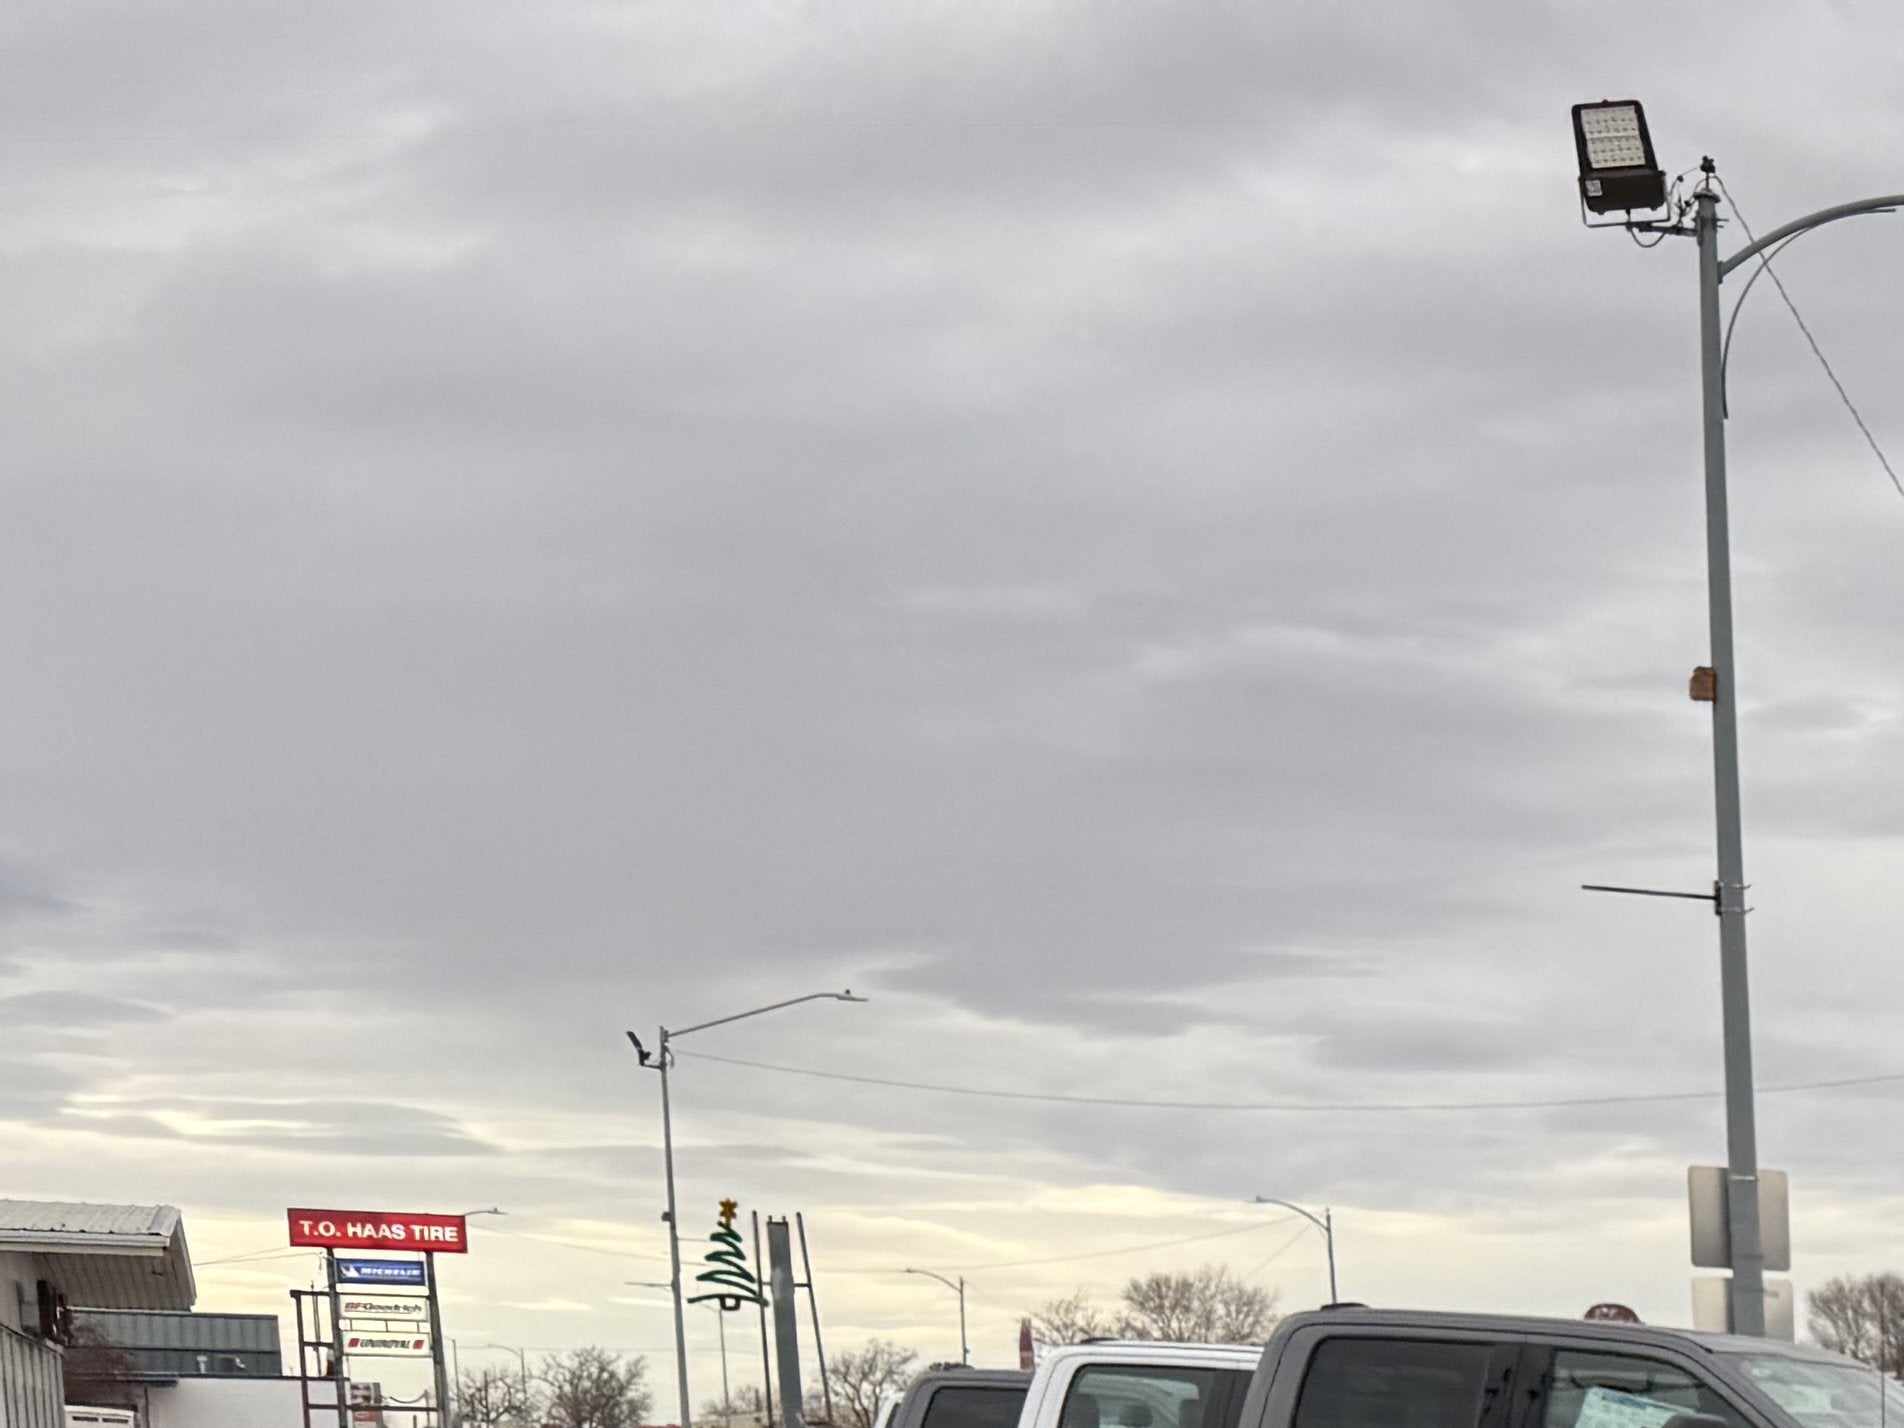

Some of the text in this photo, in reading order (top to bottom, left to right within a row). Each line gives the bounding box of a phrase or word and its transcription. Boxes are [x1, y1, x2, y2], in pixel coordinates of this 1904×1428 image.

[298, 1219, 459, 1242] T.O. HAAS TIRE
